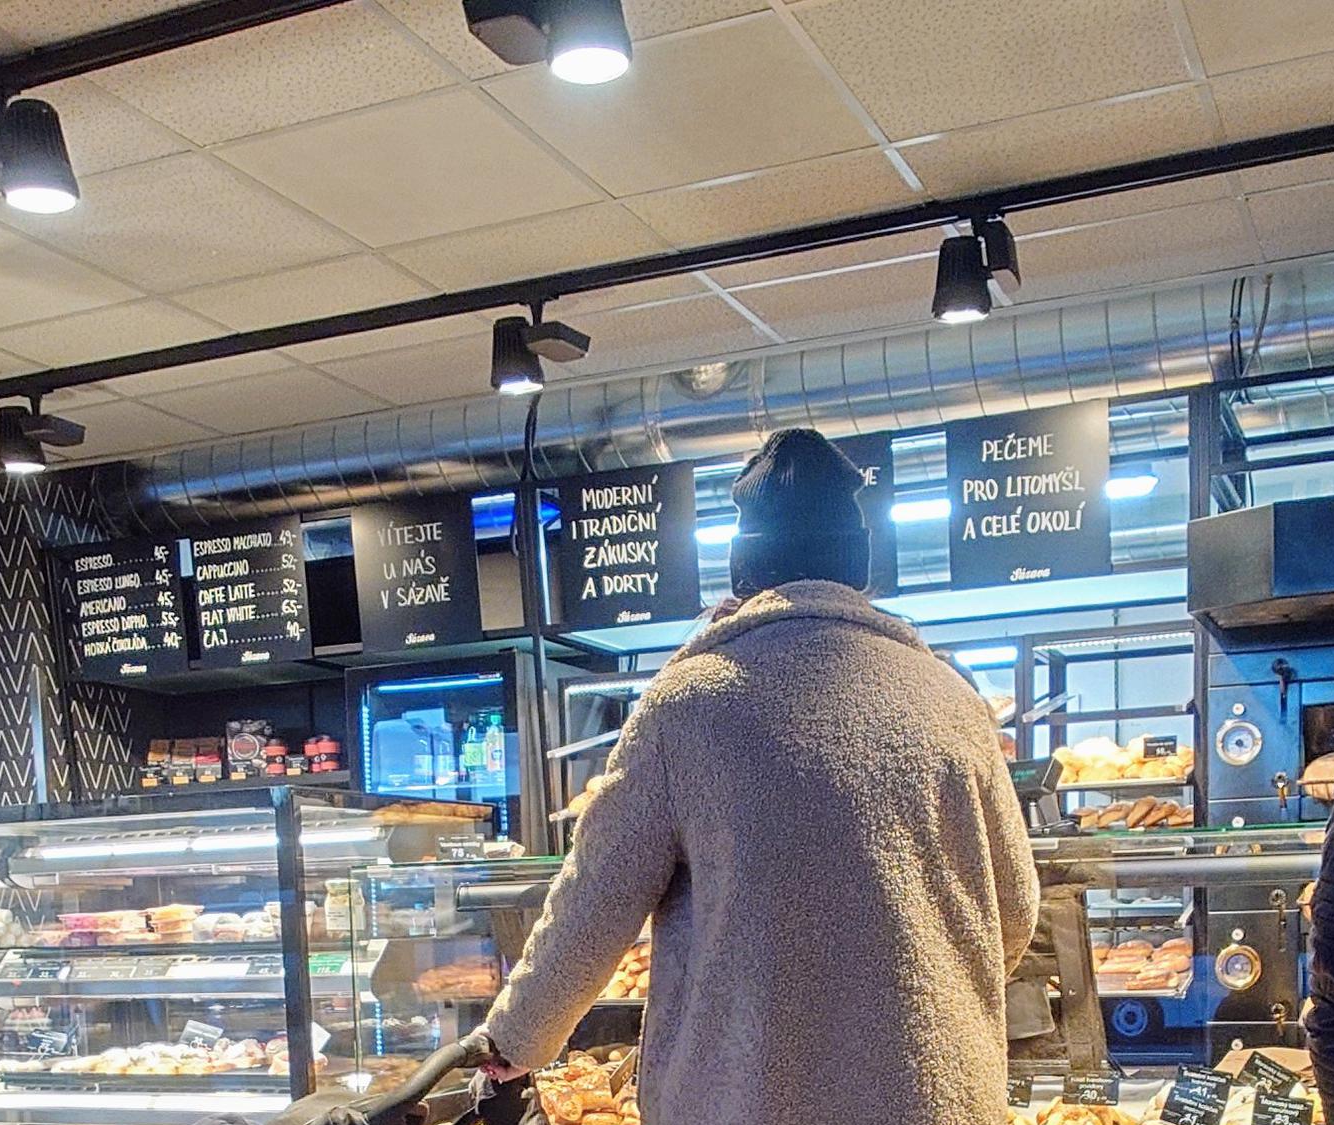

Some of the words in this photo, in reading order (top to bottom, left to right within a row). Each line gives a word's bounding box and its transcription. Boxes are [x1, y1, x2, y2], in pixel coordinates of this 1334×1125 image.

[982, 433, 1054, 462] PEČEME
[582, 474, 659, 511] MODERNÍ
[963, 478, 998, 504] PRO
[1006, 467, 1085, 498] LITOMYŠL
[377, 521, 443, 547] VÍTEJTE
[571, 520, 578, 540] I
[579, 502, 662, 539] TRADIČNÍ
[963, 517, 977, 541] A
[981, 506, 1023, 537] CELÉ
[1027, 501, 1086, 534] OKOLÍ
[193, 537, 232, 557] ESPRESSO
[583, 538, 659, 569] ZÁKUSKY
[75, 554, 113, 572] ESPRESSO
[197, 559, 250, 581] CAPPUCCINO
[383, 562, 397, 580] U
[402, 549, 436, 577] NÁS
[77, 579, 113, 595] ESPRESSO
[115, 573, 141, 589] LUNGO
[227, 583, 256, 602] LATTE
[380, 590, 389, 609] V
[396, 576, 451, 607] SÁZAVĚ
[582, 576, 597, 600] A
[602, 572, 659, 595] DORTY
[80, 596, 126, 617] AMERICANO
[201, 609, 225, 627] FLAT
[226, 604, 257, 624] WHITE
[82, 618, 120, 637] ESPRESSO
[203, 629, 228, 649] ČAJ
